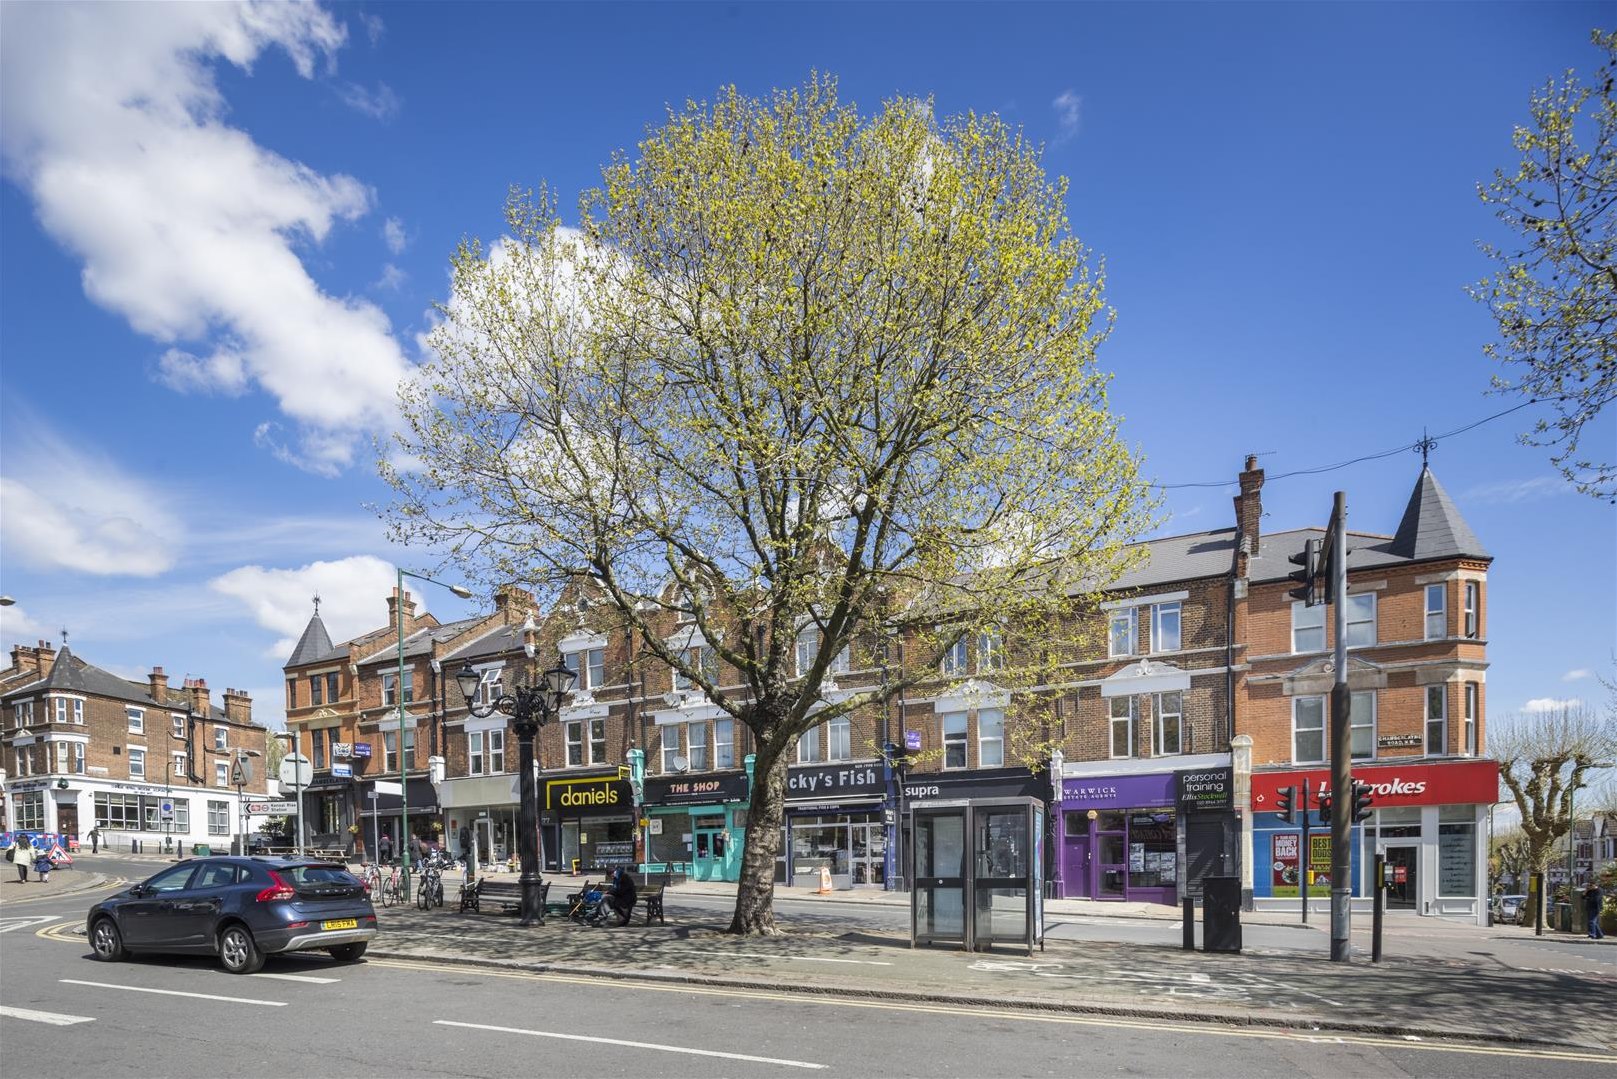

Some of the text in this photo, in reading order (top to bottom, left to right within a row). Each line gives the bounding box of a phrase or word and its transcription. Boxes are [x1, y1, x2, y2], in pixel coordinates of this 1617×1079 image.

[839, 769, 876, 786] Fish
[1183, 771, 1227, 784] personal
[670, 781, 720, 793] THE SHOP
[905, 785, 939, 798] supra
[1063, 786, 1116, 795] WARWICK
[1186, 781, 1224, 791] training
[1318, 778, 1427, 798] Lrokes
[561, 782, 618, 806] daniels
[1275, 839, 1297, 847] MONEY
[1312, 838, 1331, 848] BEST
[1275, 847, 1297, 857] BACK
[1312, 848, 1331, 857] ODDS
